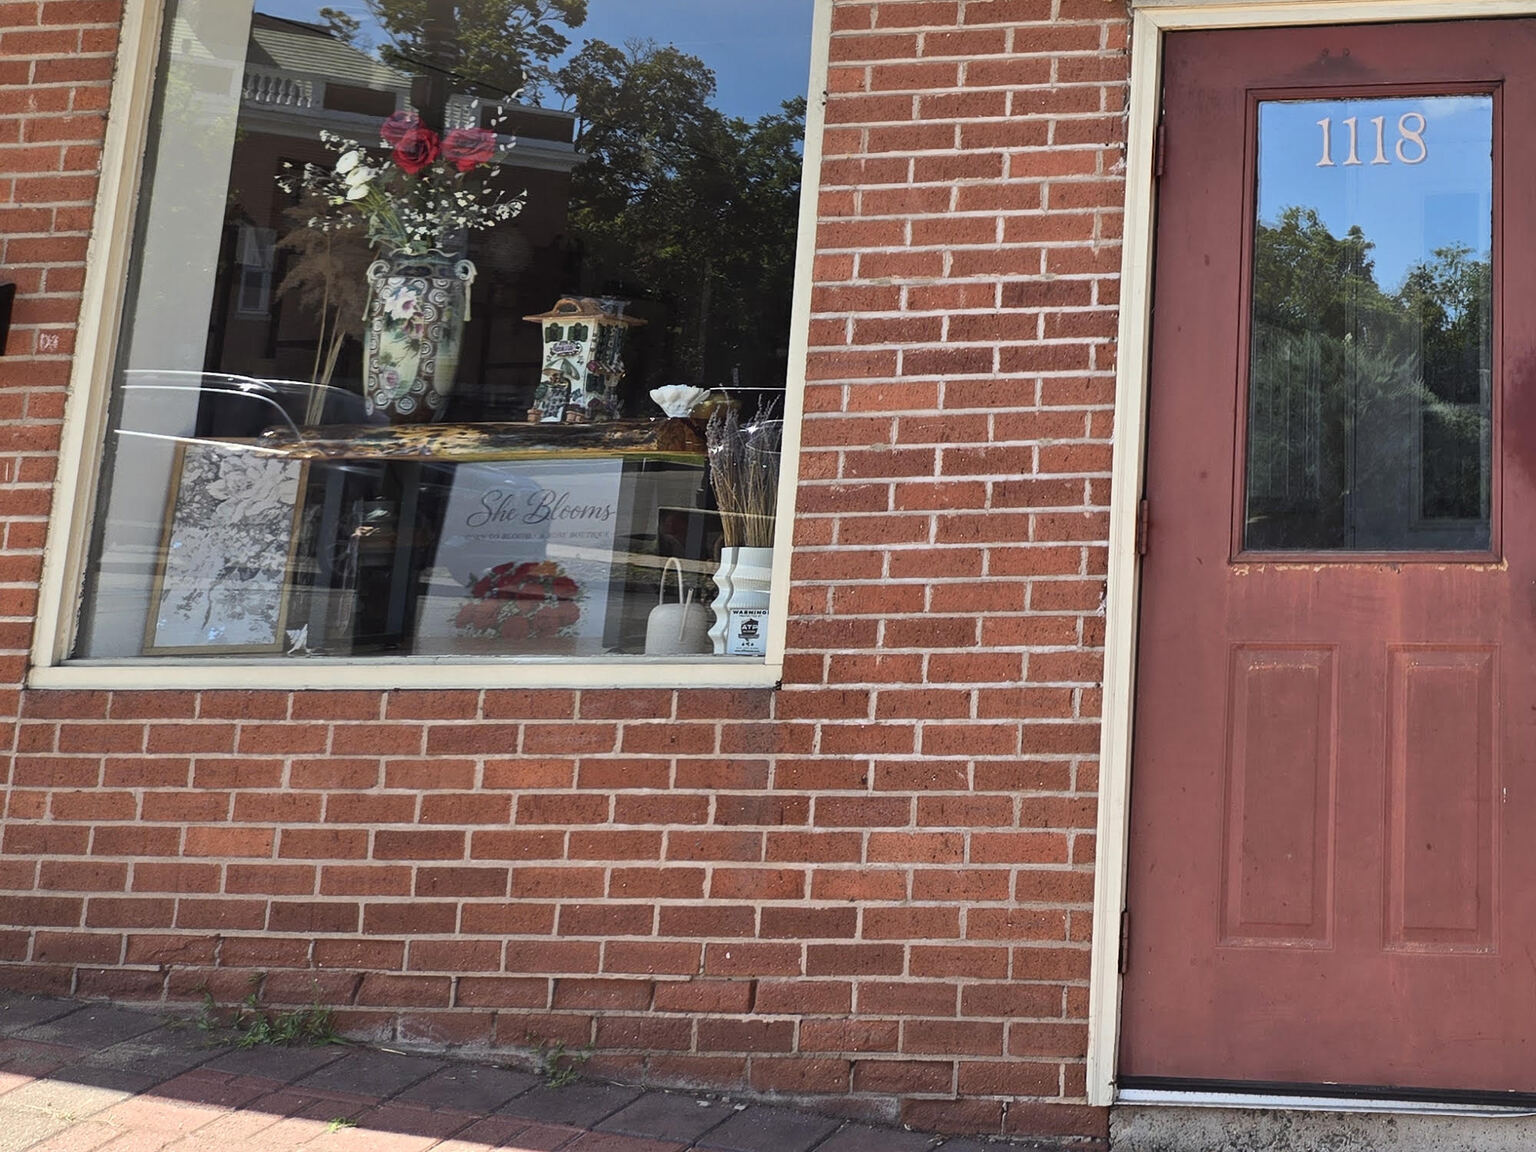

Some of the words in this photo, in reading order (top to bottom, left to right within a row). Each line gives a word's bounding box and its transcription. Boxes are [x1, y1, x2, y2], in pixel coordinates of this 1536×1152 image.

[1315, 112, 1428, 167] 1118
[466, 489, 516, 527] She
[522, 488, 615, 524] Blooms
